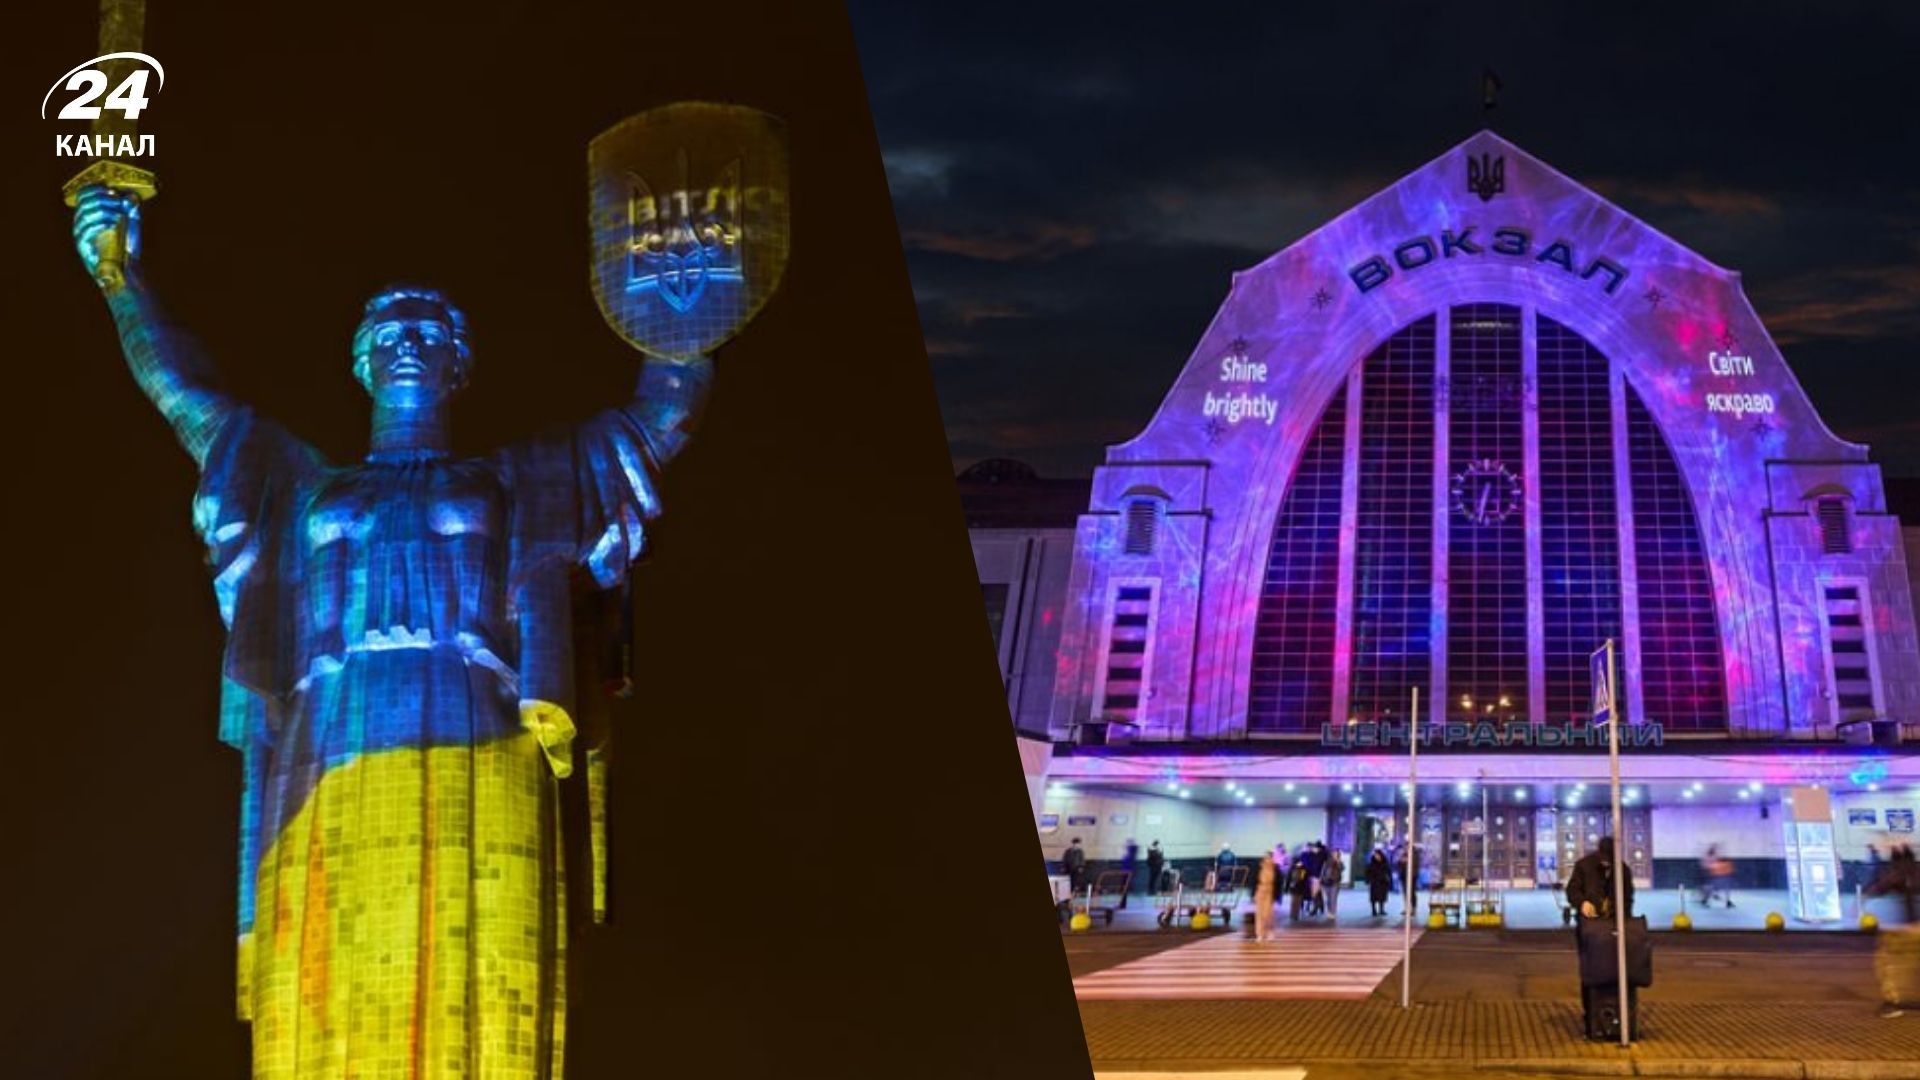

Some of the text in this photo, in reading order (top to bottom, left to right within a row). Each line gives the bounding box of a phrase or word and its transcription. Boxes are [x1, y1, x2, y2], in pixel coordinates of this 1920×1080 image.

[1349, 226, 1630, 295] ВОКЗАЛ
[1220, 356, 1267, 382] Shine
[1708, 350, 1755, 376] Світи
[1203, 391, 1278, 425] brightly
[1706, 393, 1775, 420] яскраво
